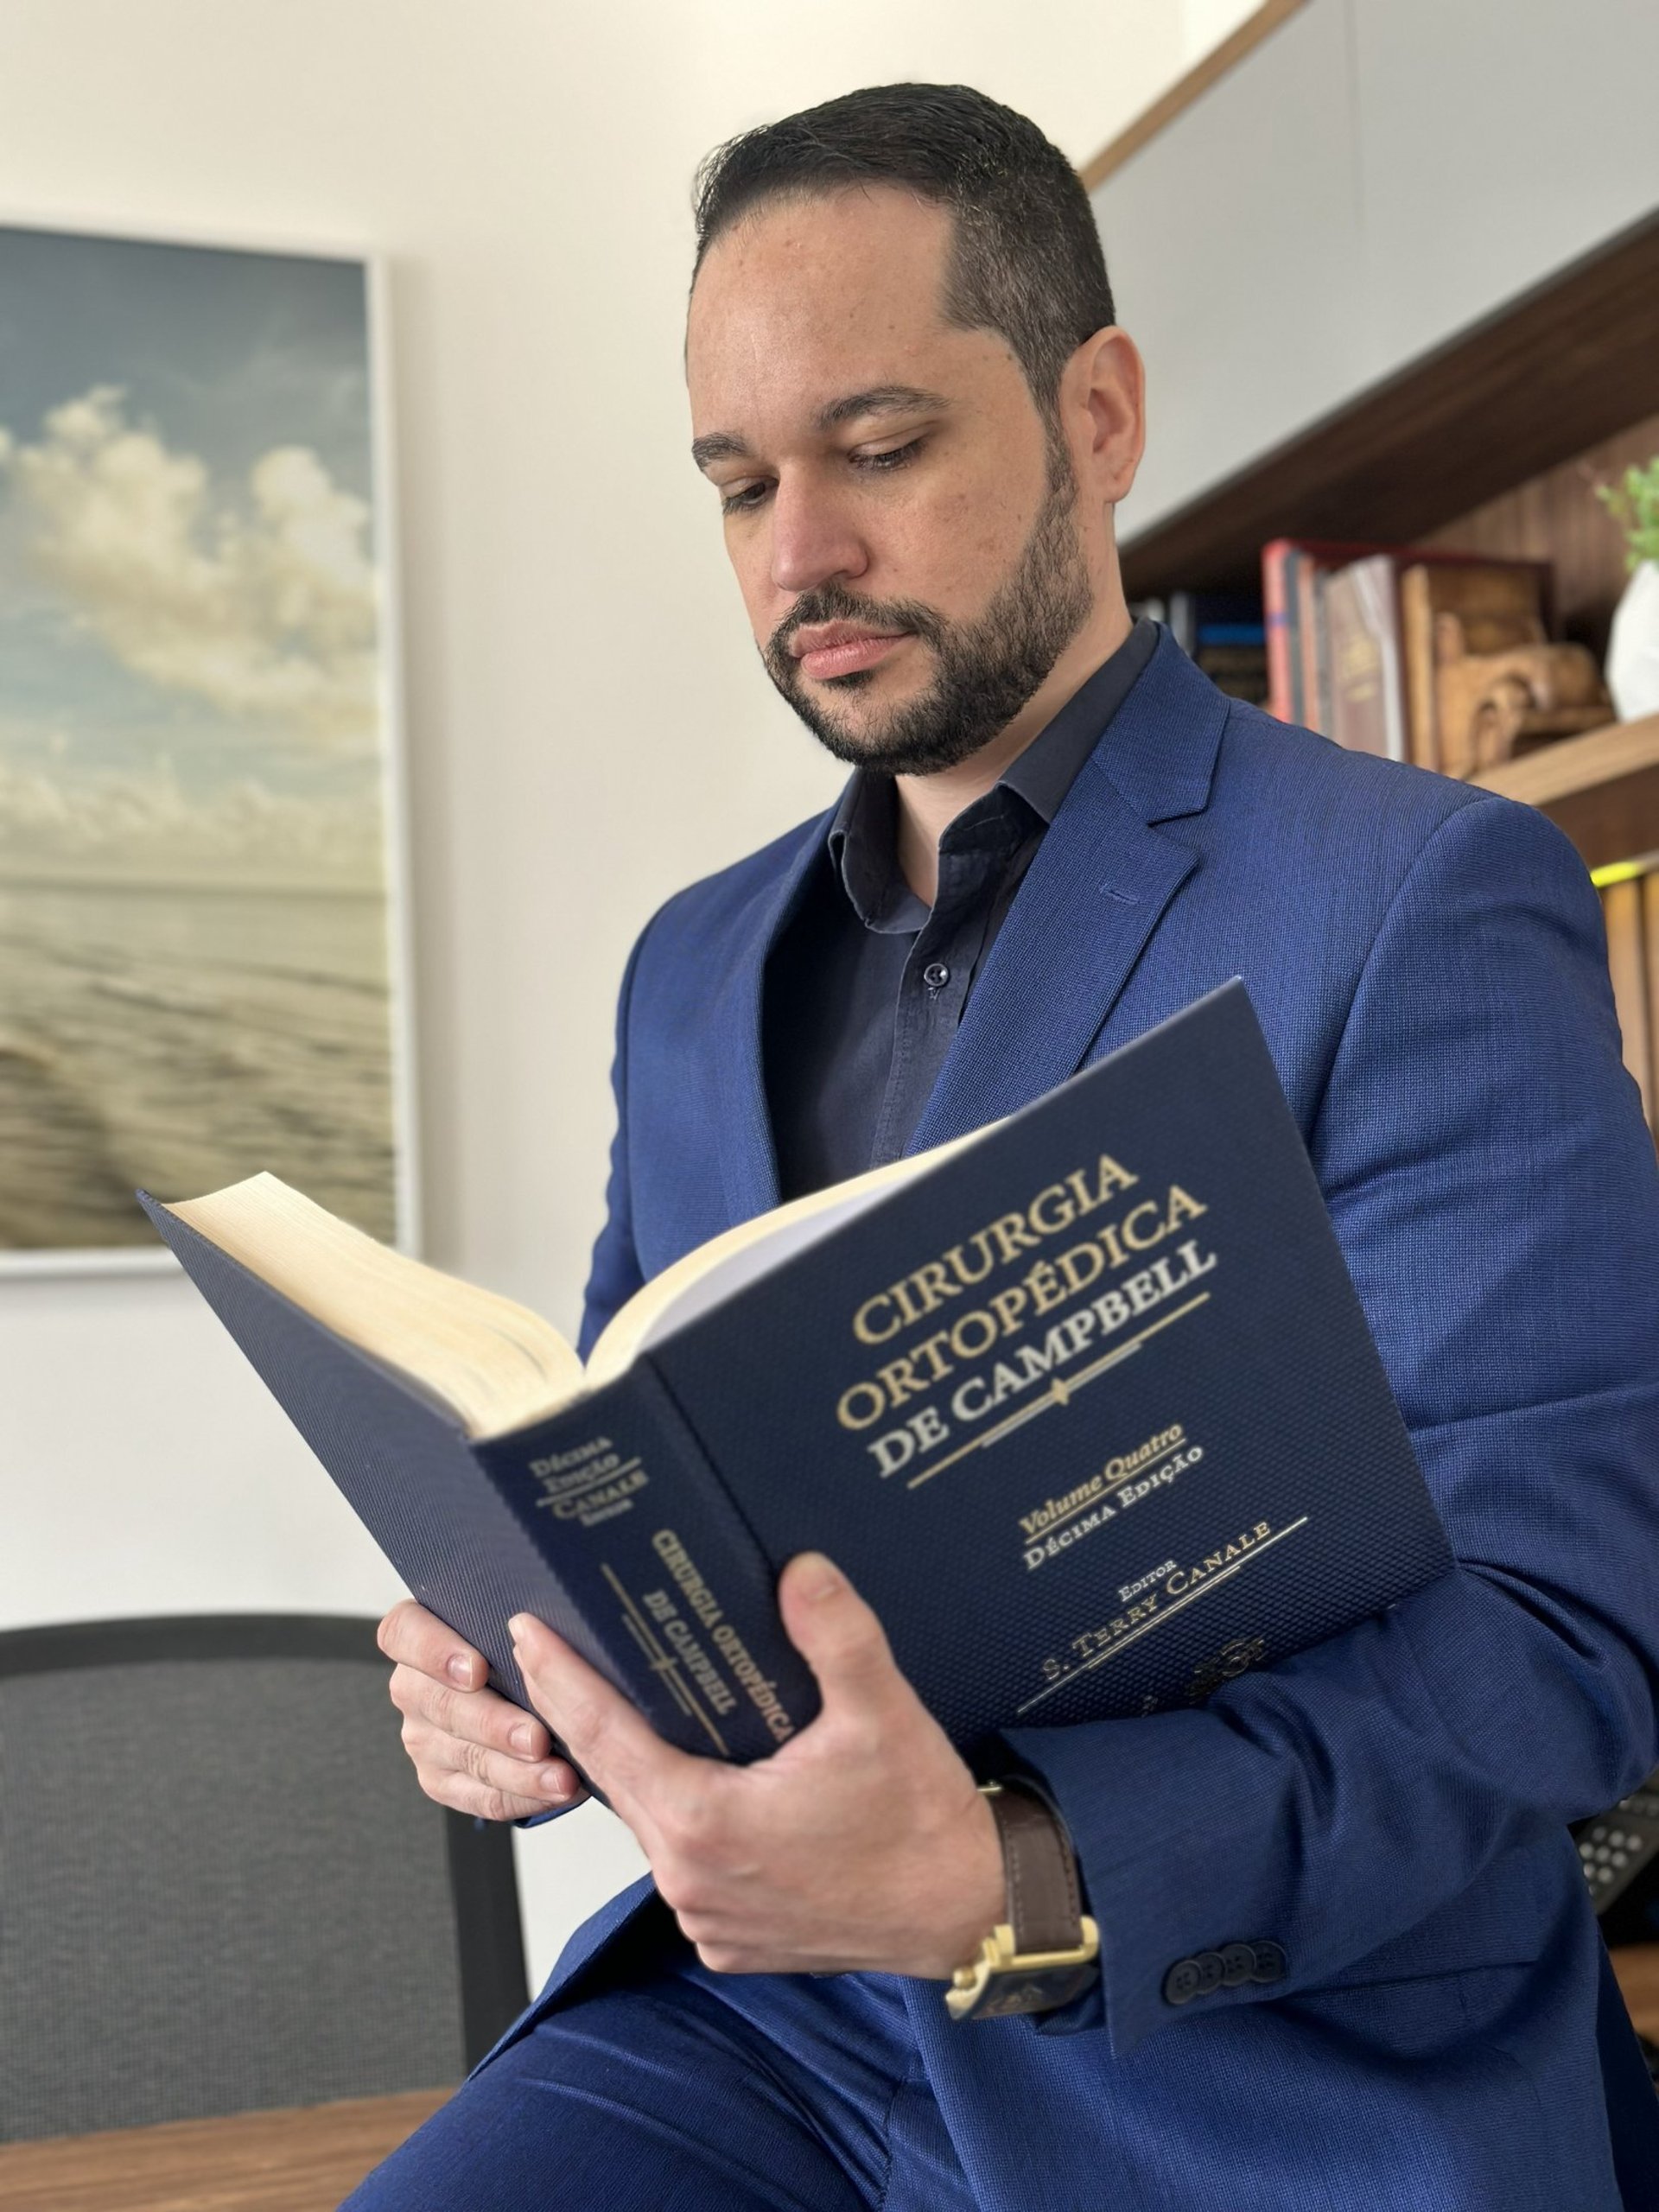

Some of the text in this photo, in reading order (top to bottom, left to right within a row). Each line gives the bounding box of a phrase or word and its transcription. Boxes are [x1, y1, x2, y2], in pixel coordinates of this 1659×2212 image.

[837, 1185, 1207, 1429] ORTOPÉDICA
[853, 1154, 1139, 1344] CIRURGIA
[868, 1240, 1217, 1478] DE CAMPBELL
[1019, 1424, 1183, 1535] Volume Quatro
[1023, 1446, 1204, 1571] DÉCIMA EDIÇÃO
[652, 1529, 723, 1628] CIRURGIA
[1073, 1594, 1159, 1657] TERRY
[1166, 1522, 1271, 1595] CANALE
[643, 1590, 737, 1715] DE CAMPBELL
